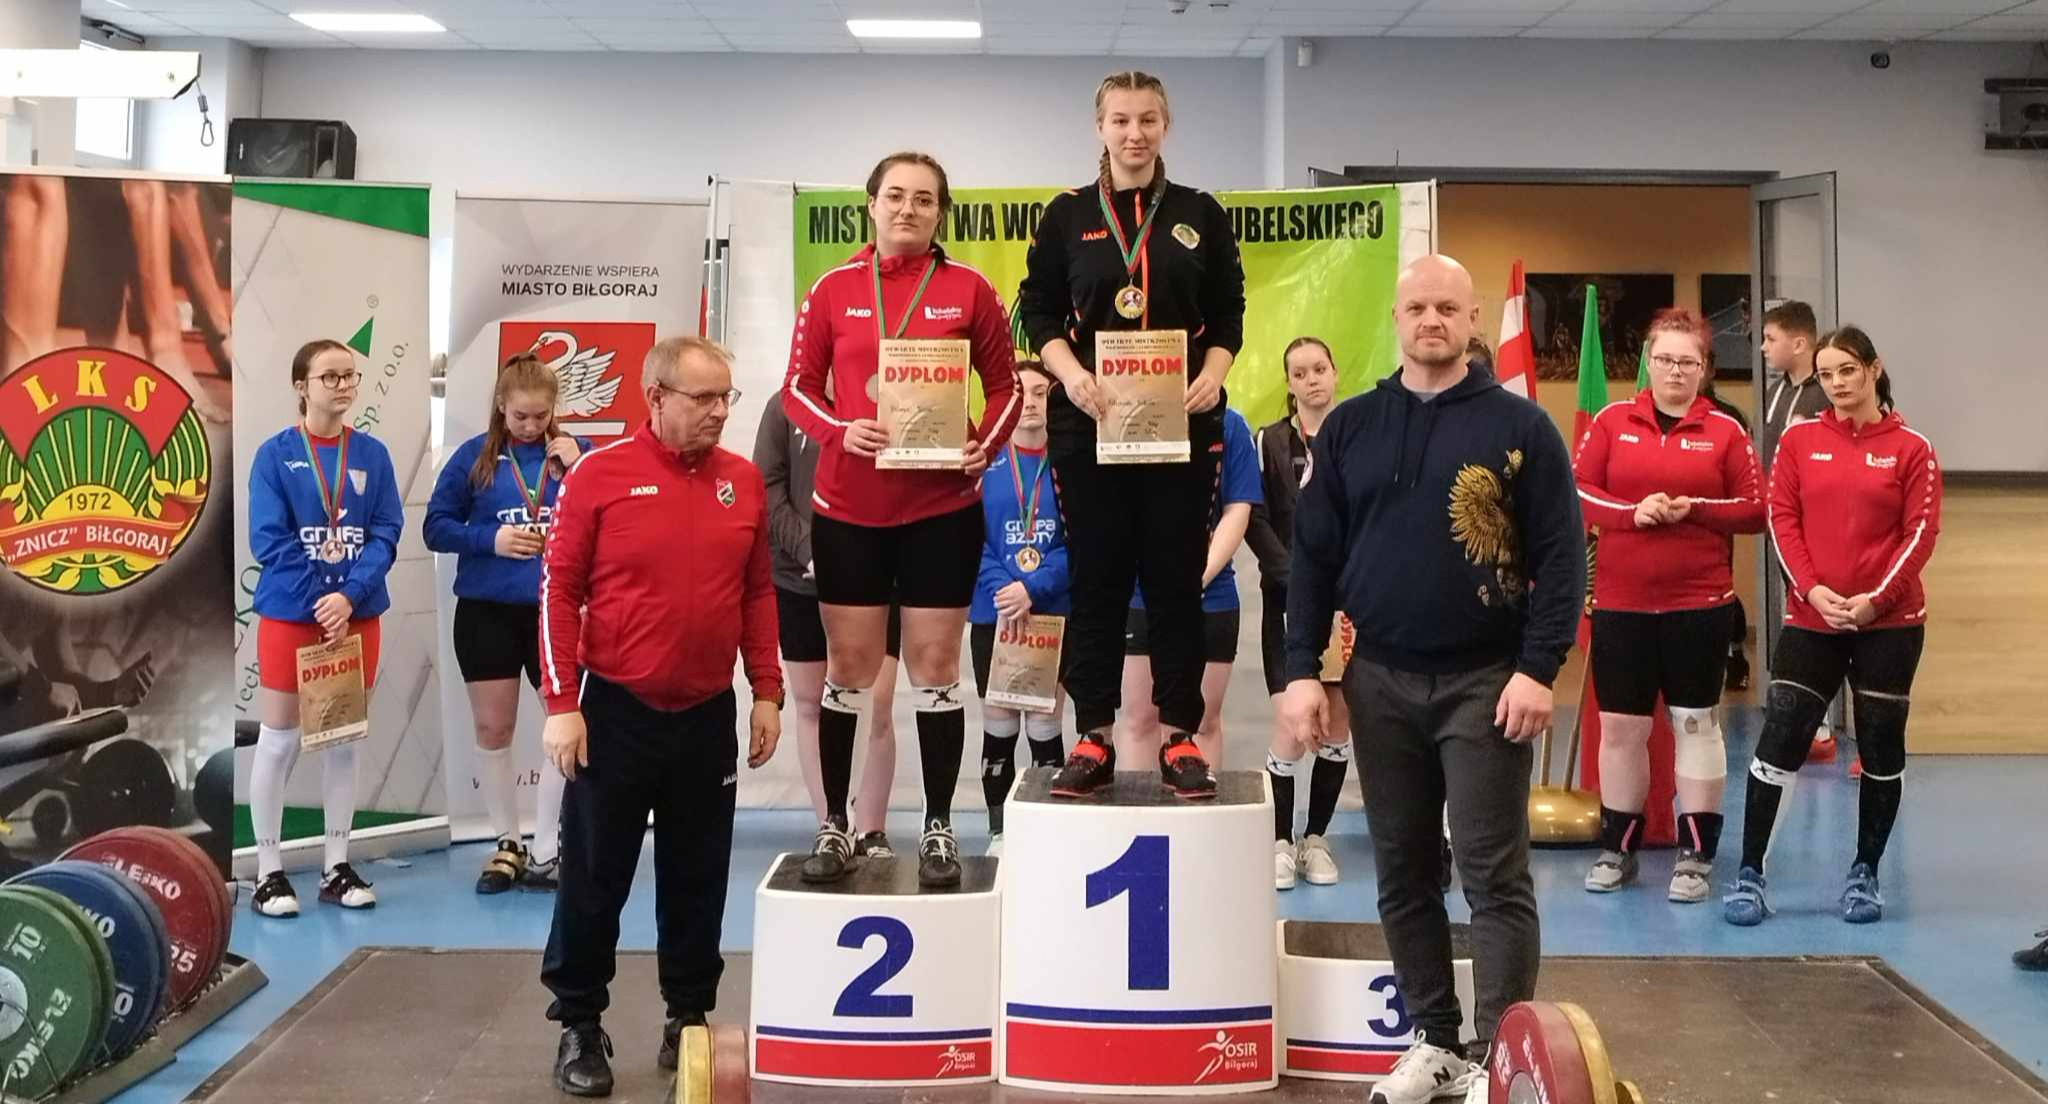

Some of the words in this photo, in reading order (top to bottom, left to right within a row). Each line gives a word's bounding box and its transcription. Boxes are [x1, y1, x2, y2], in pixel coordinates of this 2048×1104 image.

[1224, 201, 1384, 243] UBELSKIEGO
[1082, 231, 1108, 240] JAKO
[502, 264, 593, 276] WYDARZENIE
[597, 265, 659, 277] WSPIERA
[502, 282, 567, 296] MIASTO
[572, 283, 658, 297] BIŁGORAJ
[846, 307, 872, 318] JAKO
[884, 366, 964, 383] DYPLOM
[1102, 358, 1183, 376] DYPLOM
[629, 485, 659, 496] JAKO
[65, 492, 112, 511] 1972
[302, 656, 361, 684] DYPLOM
[100, 852, 182, 901] ELEIKO
[1086, 836, 1170, 991] 1
[11, 925, 41, 960] 10
[833, 916, 914, 1018] 2
[114, 993, 134, 1017] 0
[1367, 975, 1413, 1038] 3
